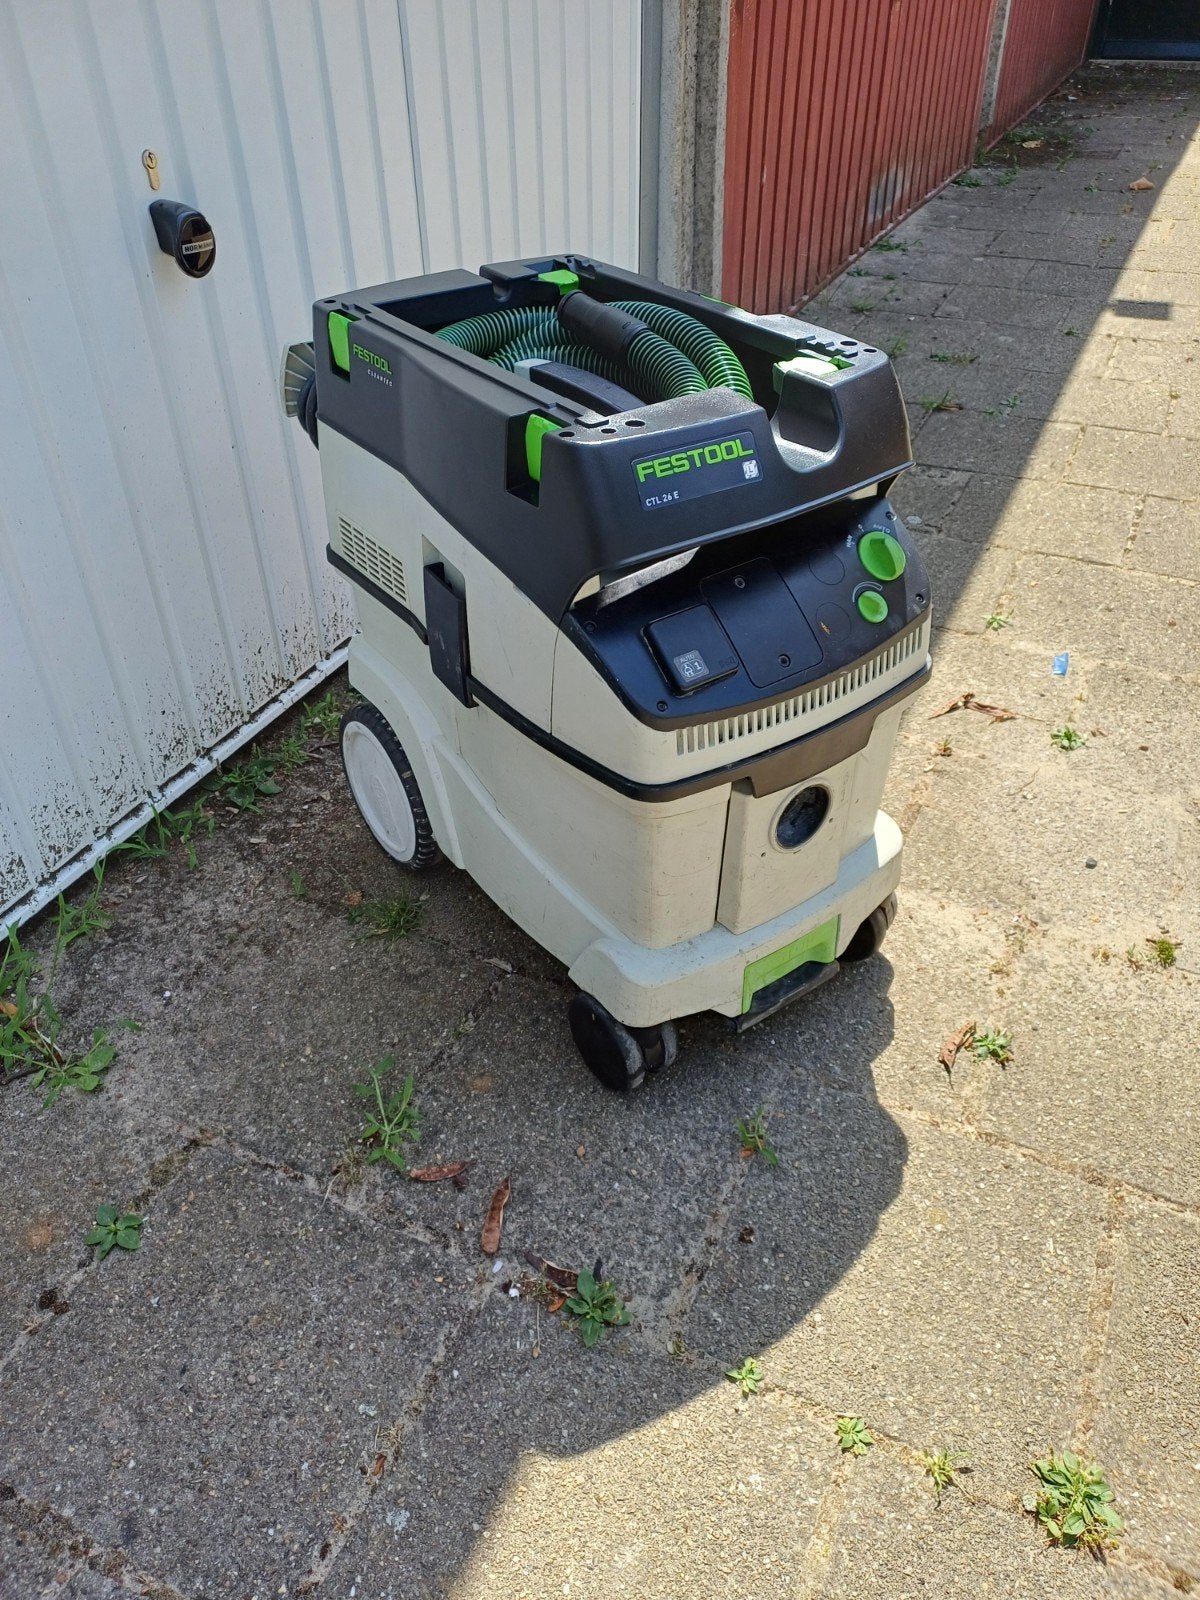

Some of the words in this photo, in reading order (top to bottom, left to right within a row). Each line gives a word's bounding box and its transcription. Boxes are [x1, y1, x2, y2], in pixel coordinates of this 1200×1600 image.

[353, 343, 392, 375] FESTOOL
[636, 438, 754, 482] FESTOOL
[645, 496, 662, 507] CTL
[662, 493, 673, 503] 26
[673, 490, 680, 499] E
